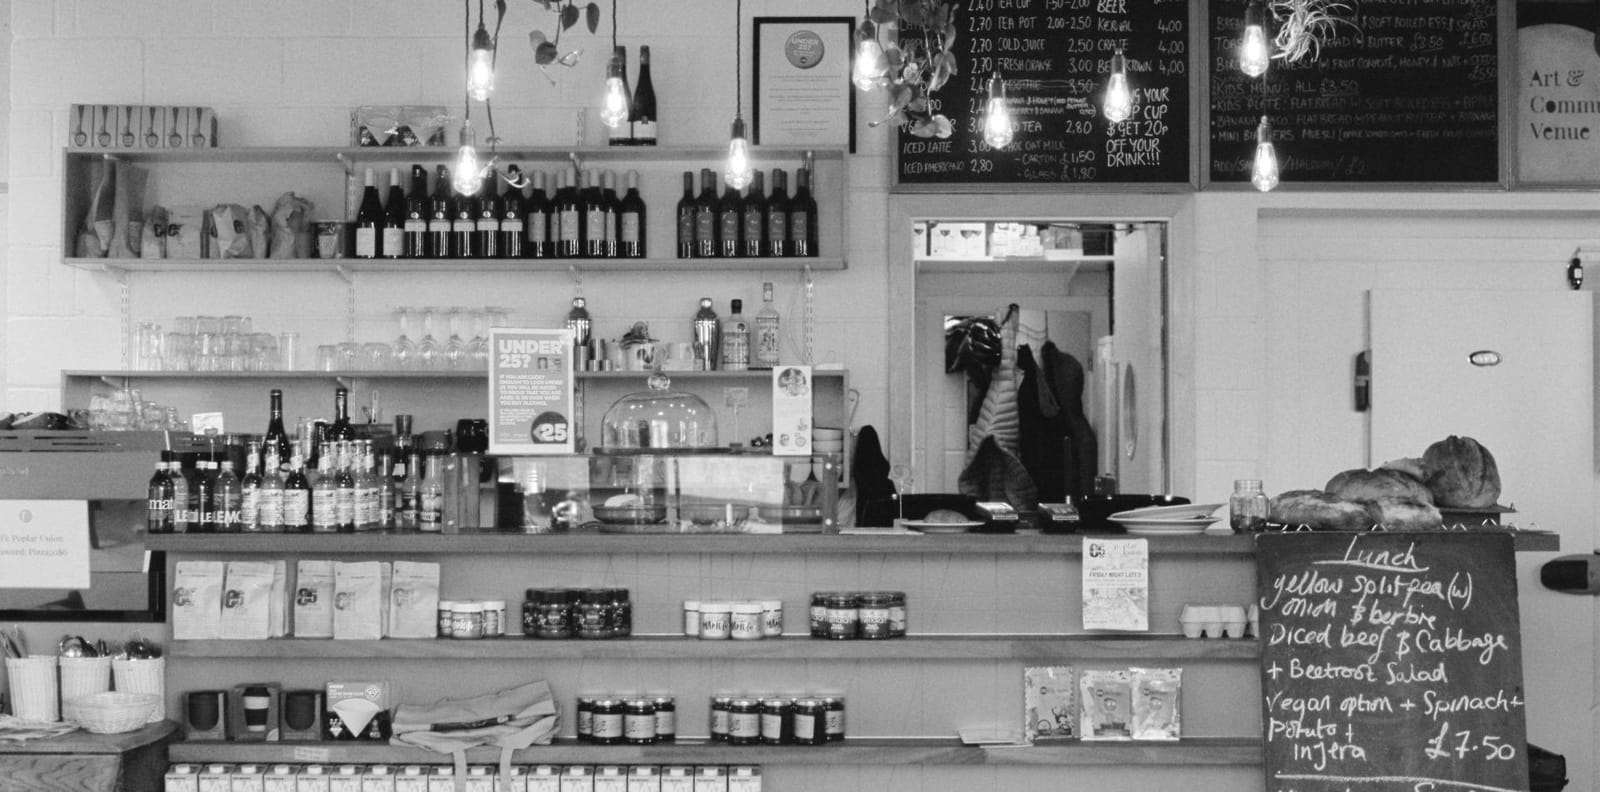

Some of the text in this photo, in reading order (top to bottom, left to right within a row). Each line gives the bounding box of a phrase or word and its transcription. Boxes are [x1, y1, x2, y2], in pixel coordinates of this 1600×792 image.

[1097, 0, 1127, 14] BEER
[998, 16, 1015, 30] TEA
[1019, 16, 1038, 29] POT
[998, 37, 1020, 52] COLD
[1529, 69, 1585, 88] Art &
[1144, 87, 1170, 103] YOUR
[1144, 104, 1168, 120] CUP
[1022, 121, 1042, 134] TEA
[1117, 121, 1141, 138] GET
[1530, 122, 1590, 140] Venue
[904, 142, 926, 154] ICED
[928, 140, 952, 154] LATTE
[1106, 137, 1161, 154] OFF YOUR
[904, 161, 924, 175] ICED
[499, 339, 563, 355] UNDER
[499, 353, 532, 369] 25?
[1343, 534, 1419, 571] Lunch
[1261, 569, 1344, 611] yellow
[1281, 597, 1338, 618] onion
[1267, 622, 1333, 649] Diced
[1415, 626, 1509, 666] Cabbage
[1385, 661, 1449, 686] Salad
[1265, 689, 1331, 722] Vegan
[1423, 688, 1510, 722] Spinach
